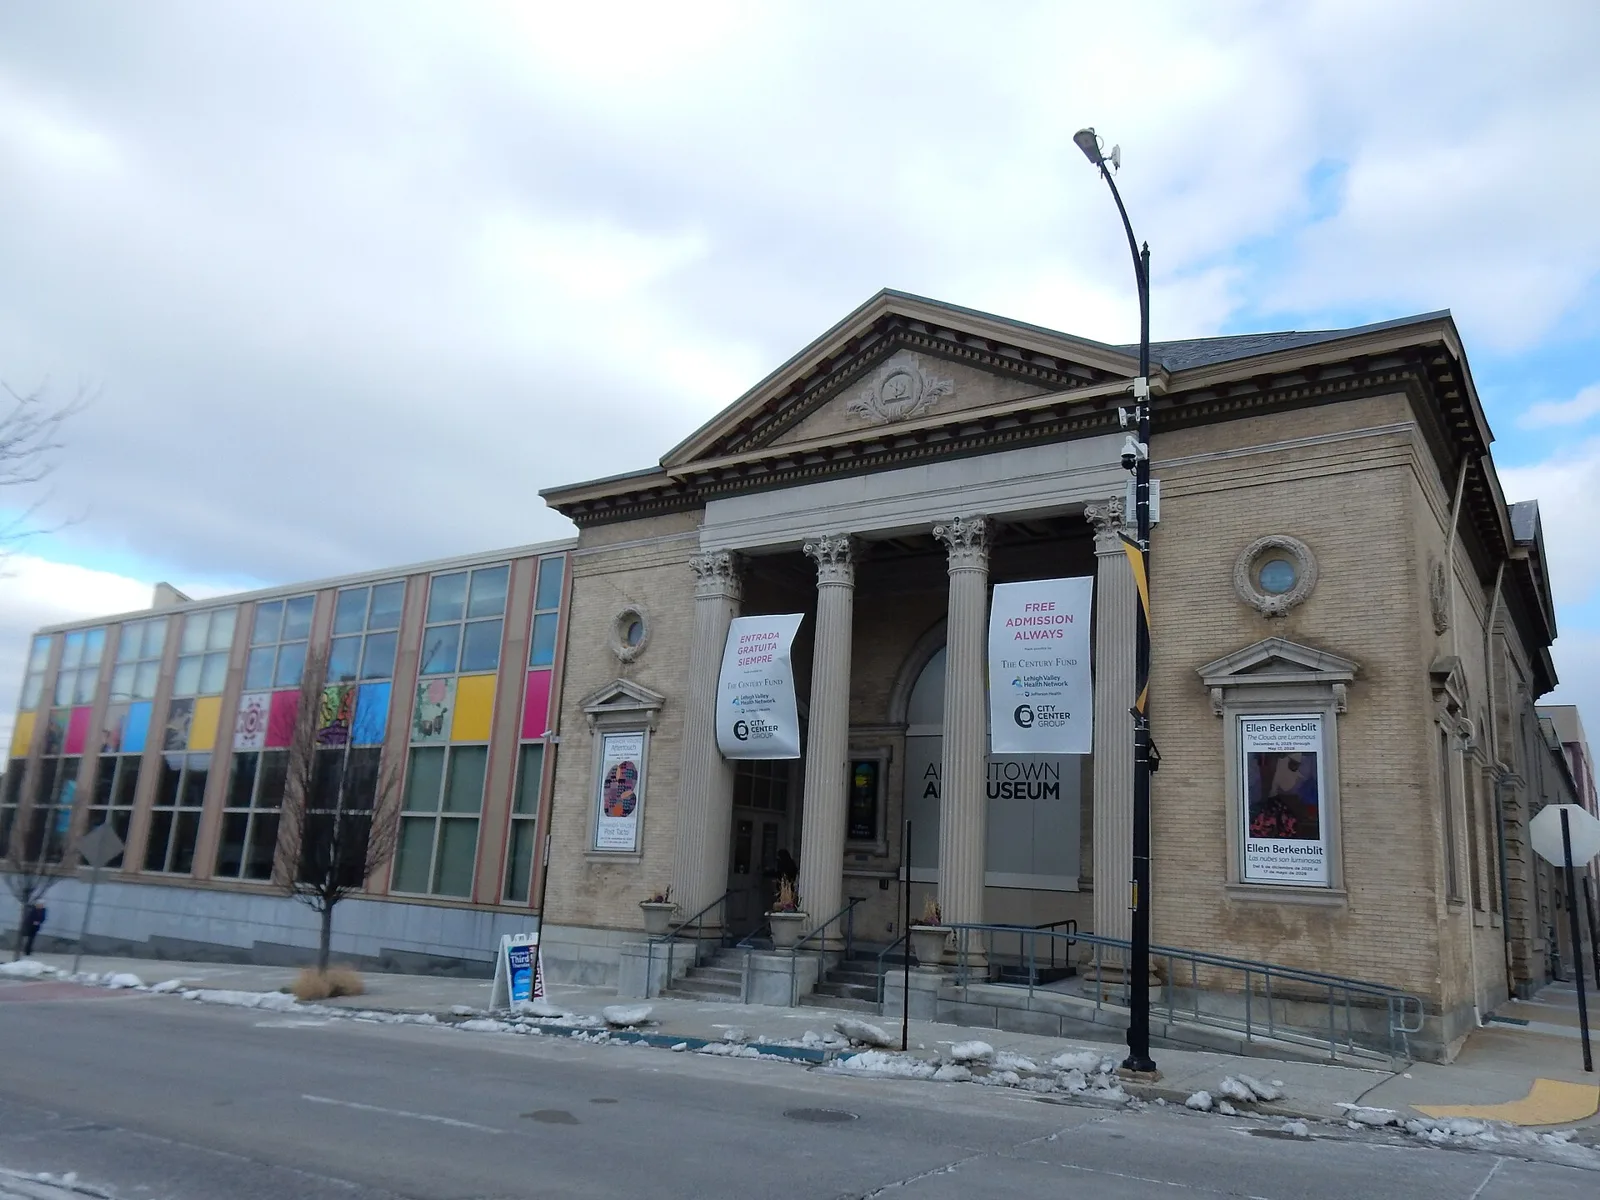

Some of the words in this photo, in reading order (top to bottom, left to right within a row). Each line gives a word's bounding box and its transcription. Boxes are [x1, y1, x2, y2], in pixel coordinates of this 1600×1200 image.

[1025, 602, 1055, 612] FREE
[1006, 615, 1073, 627] ADMISSION
[740, 632, 780, 644] ENTRADA
[1014, 629, 1063, 640] ALWAYS
[738, 642, 777, 654] GRATUITA
[738, 654, 772, 666] SIEMPRE
[1056, 658, 1078, 666] FUND
[1246, 724, 1268, 732] Ellen
[1270, 722, 1317, 732] Berkenblit
[924, 762, 1060, 780] ATOWN
[986, 782, 1060, 800] USEUM
[1247, 844, 1270, 852] Ellen
[1272, 844, 1323, 855] Berkenblit
[510, 955, 530, 963] Third
